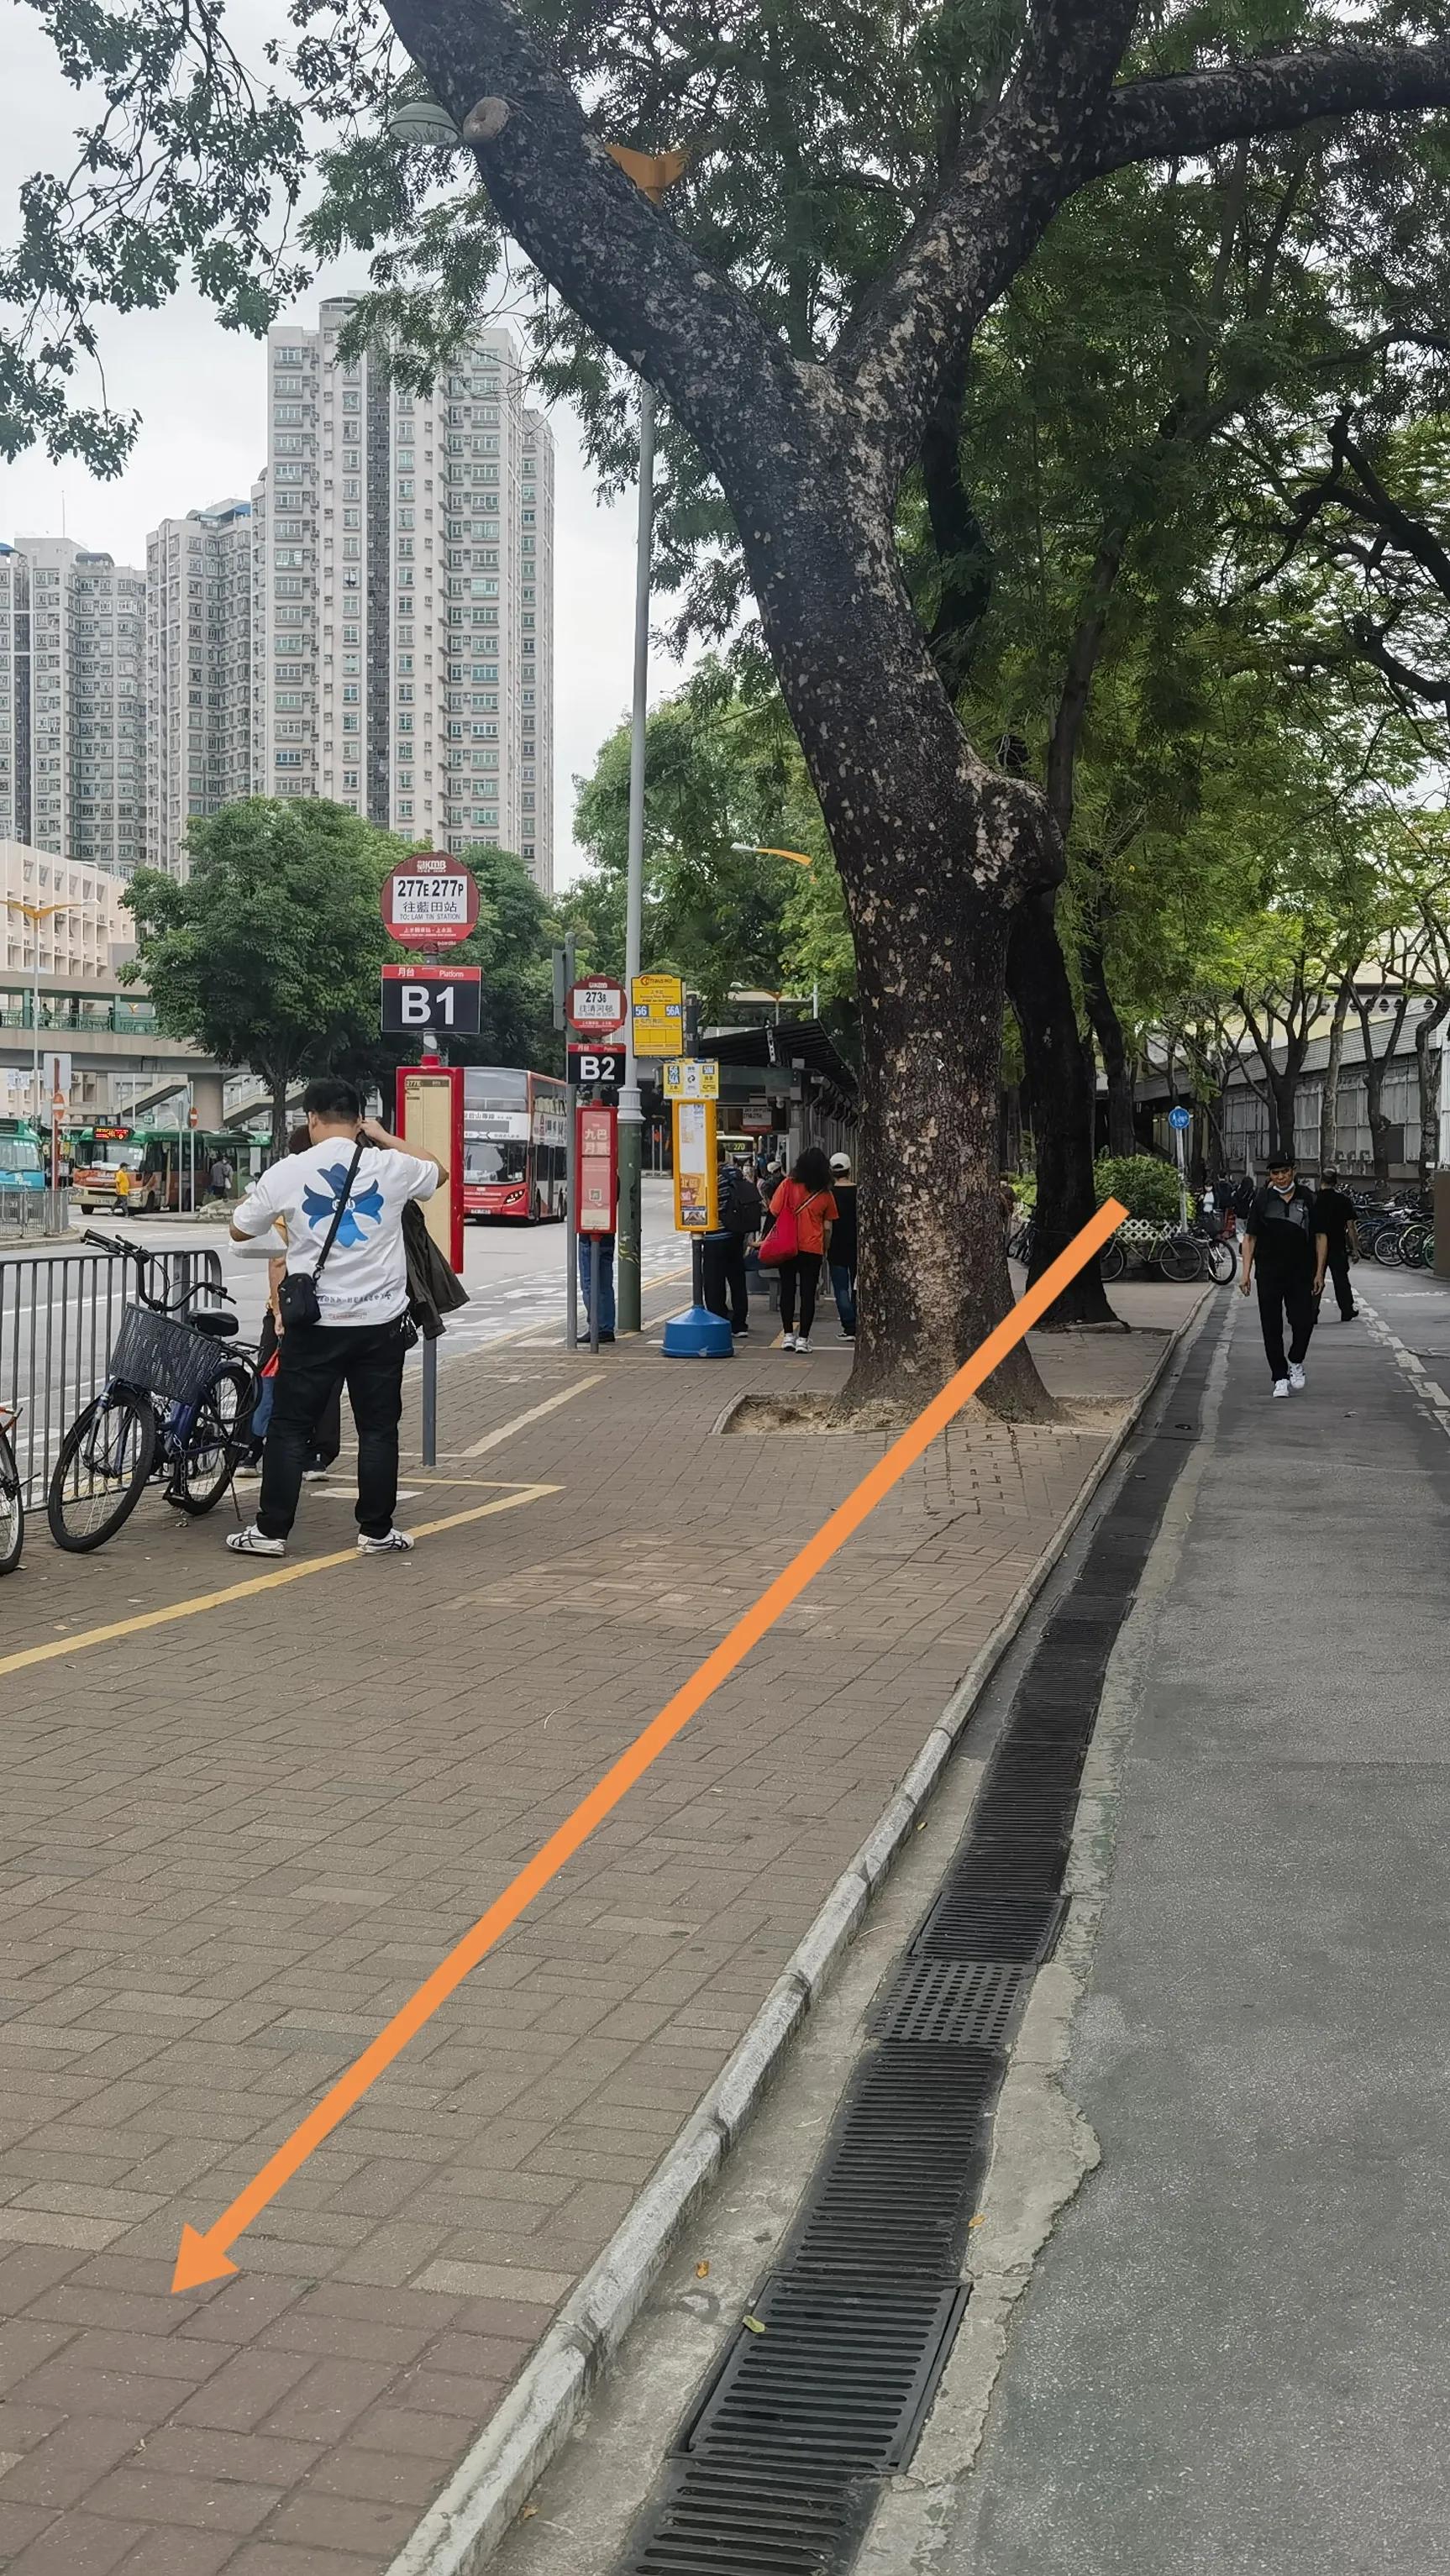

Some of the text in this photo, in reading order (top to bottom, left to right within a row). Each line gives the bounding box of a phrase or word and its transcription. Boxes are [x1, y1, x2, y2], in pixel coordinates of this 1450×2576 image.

[397, 879, 464, 897] 277E 277P
[403, 901, 457, 913] 往藍田站
[398, 968, 414, 977] 月台
[402, 985, 454, 1025] B1
[635, 1005, 680, 1016] 56 56A
[581, 1056, 615, 1080] B2
[585, 1128, 607, 1141] 九巴
